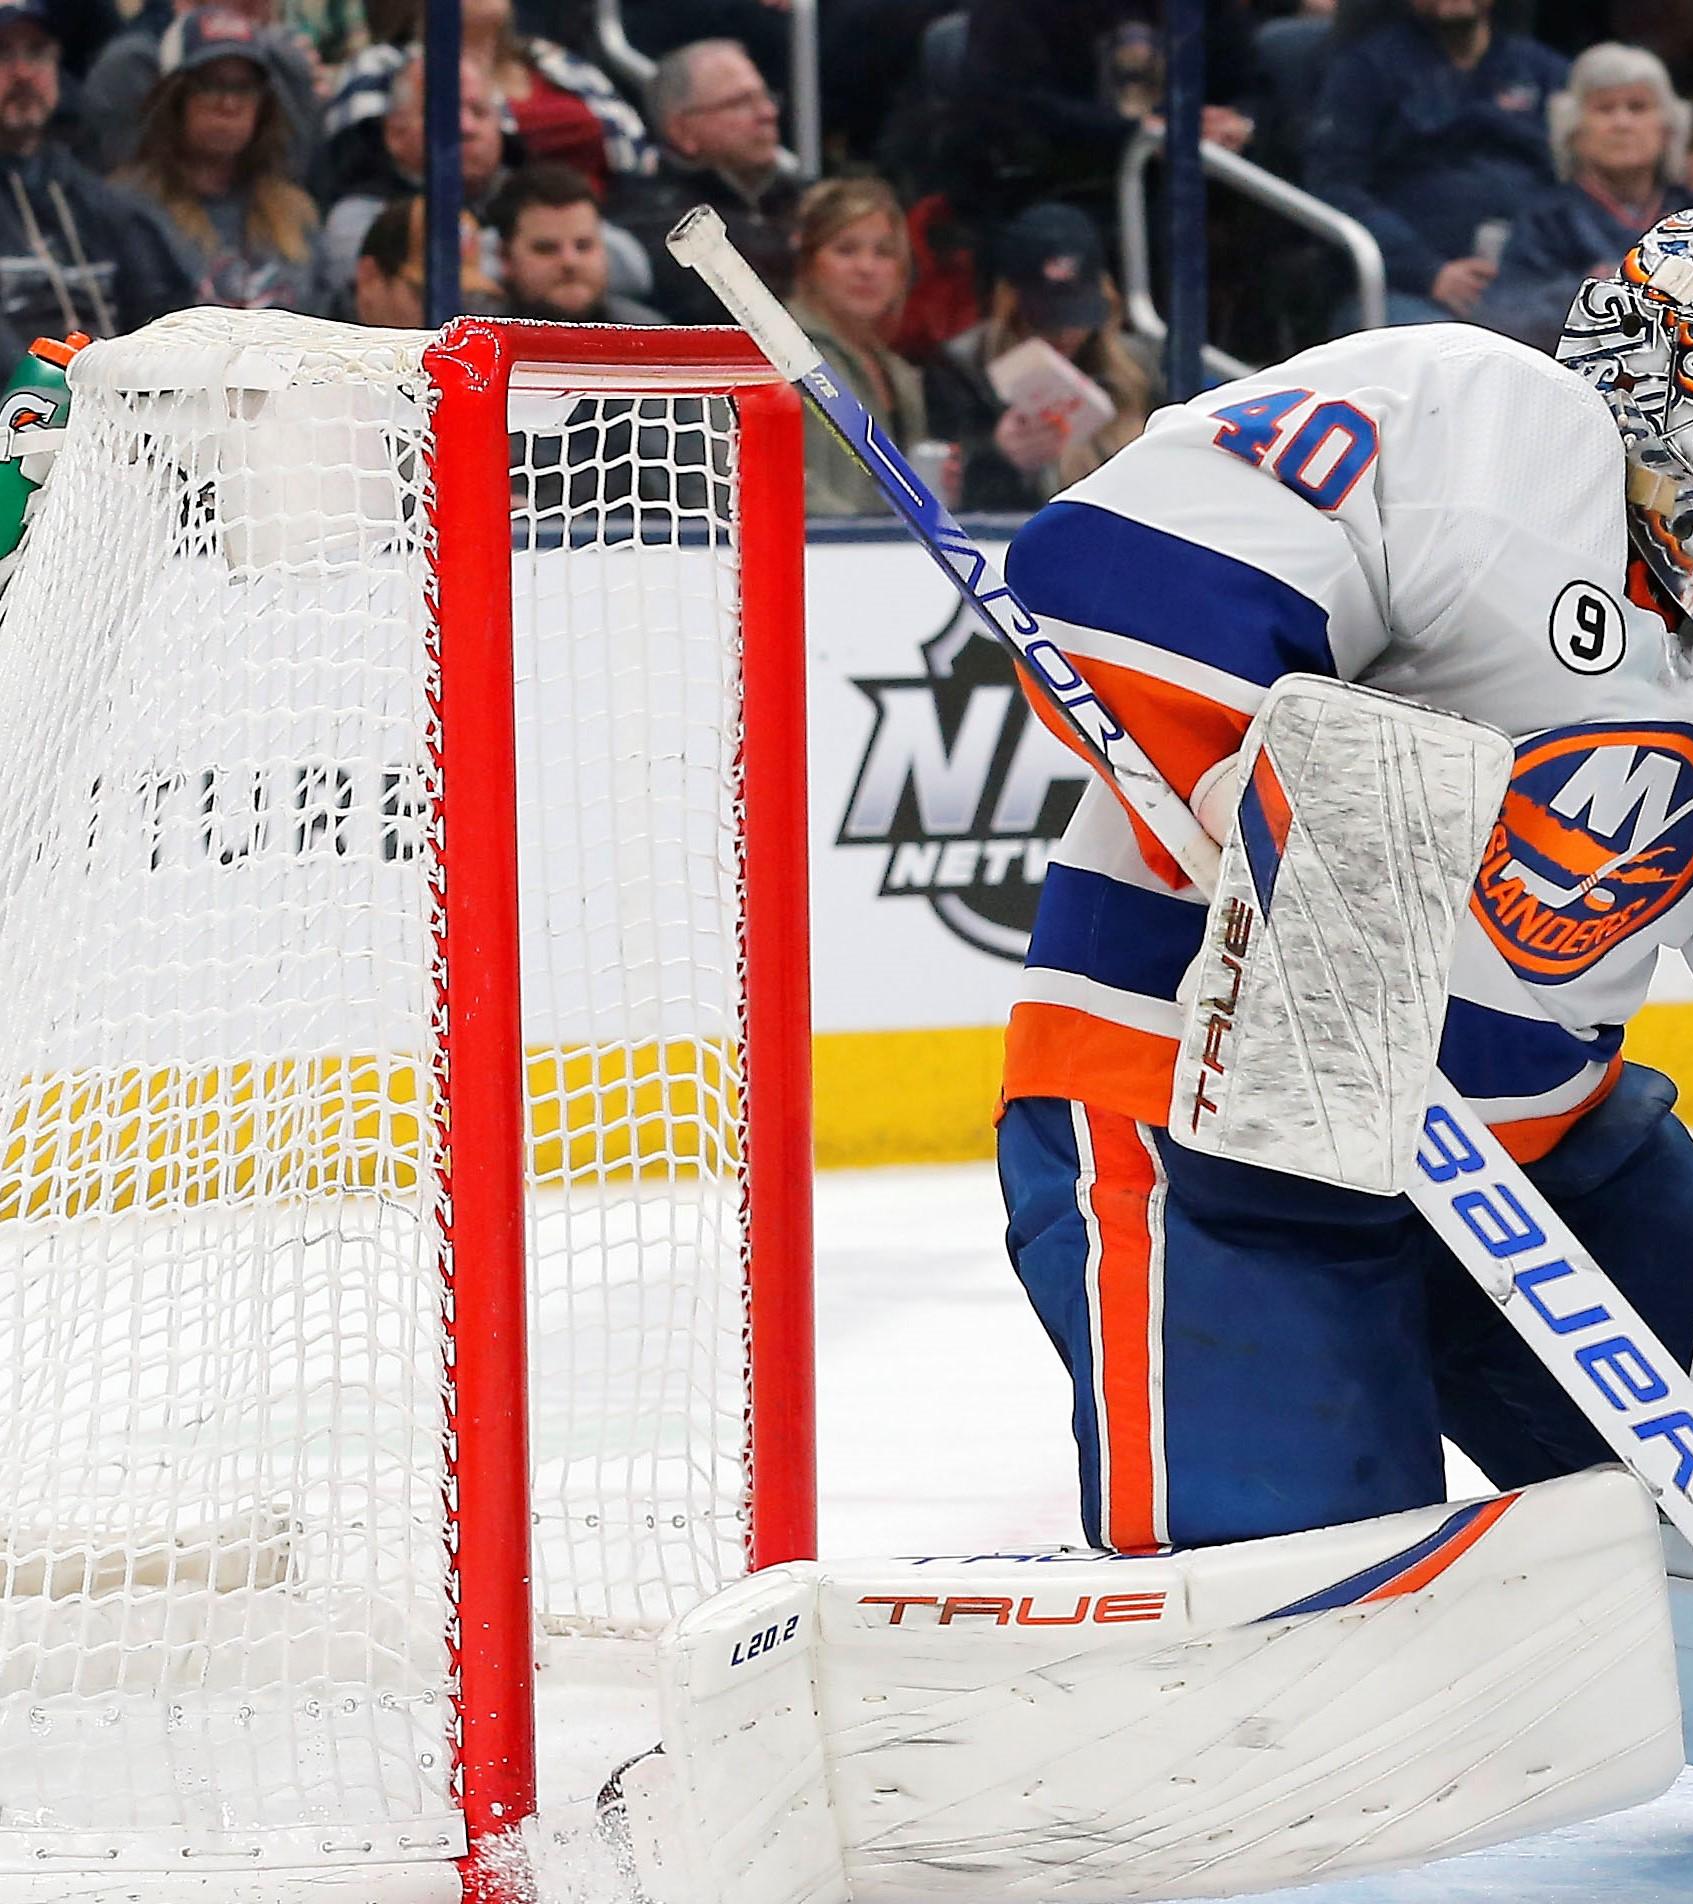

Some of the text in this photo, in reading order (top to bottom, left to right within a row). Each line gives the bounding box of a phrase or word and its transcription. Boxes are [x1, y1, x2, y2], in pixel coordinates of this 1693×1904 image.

[1206, 387, 1382, 512] 40
[1569, 594, 1607, 661] 9
[1479, 823, 1649, 954] SLANDERS
[1191, 896, 1255, 1135] TRUE
[730, 1614, 801, 1667] L20.2
[857, 1591, 1168, 1626] TRUE
